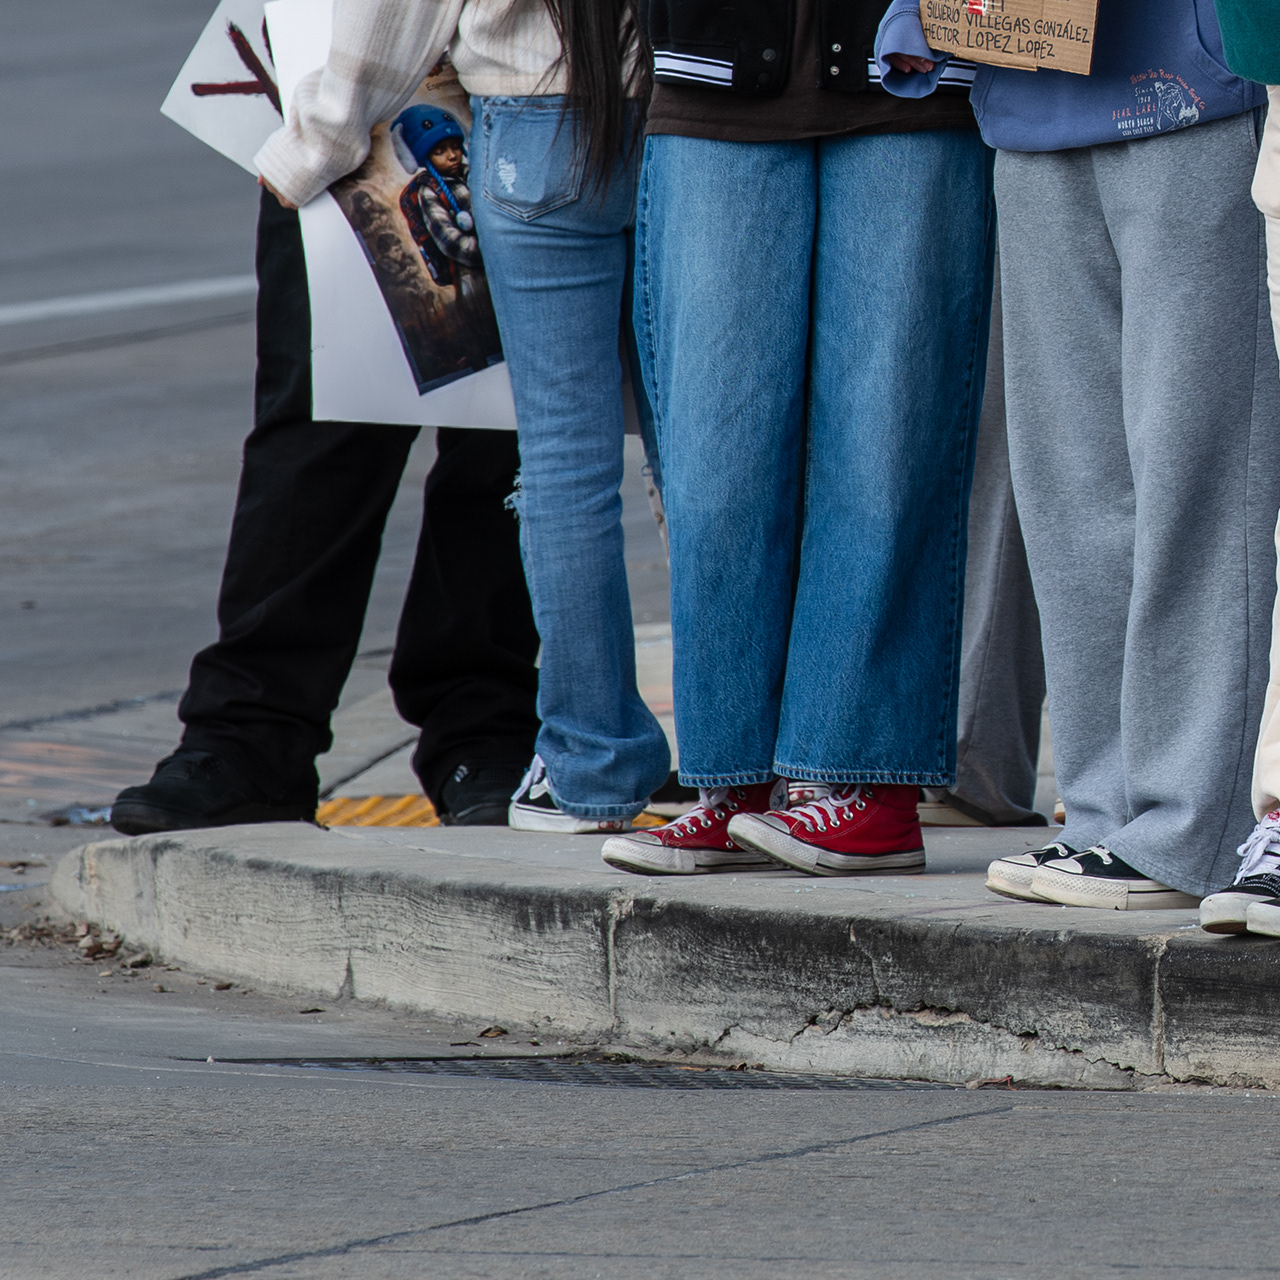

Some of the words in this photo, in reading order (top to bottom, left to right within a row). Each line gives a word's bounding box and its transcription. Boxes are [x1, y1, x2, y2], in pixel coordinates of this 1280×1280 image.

[926, 1, 960, 24] SILVERIO
[966, 14, 1031, 35] VILLEGAS
[924, 22, 960, 45] HECTOR
[966, 30, 1013, 54] LOPEZ
[1017, 38, 1055, 60] LOPEZ
[1136, 102, 1157, 116] LAKE
